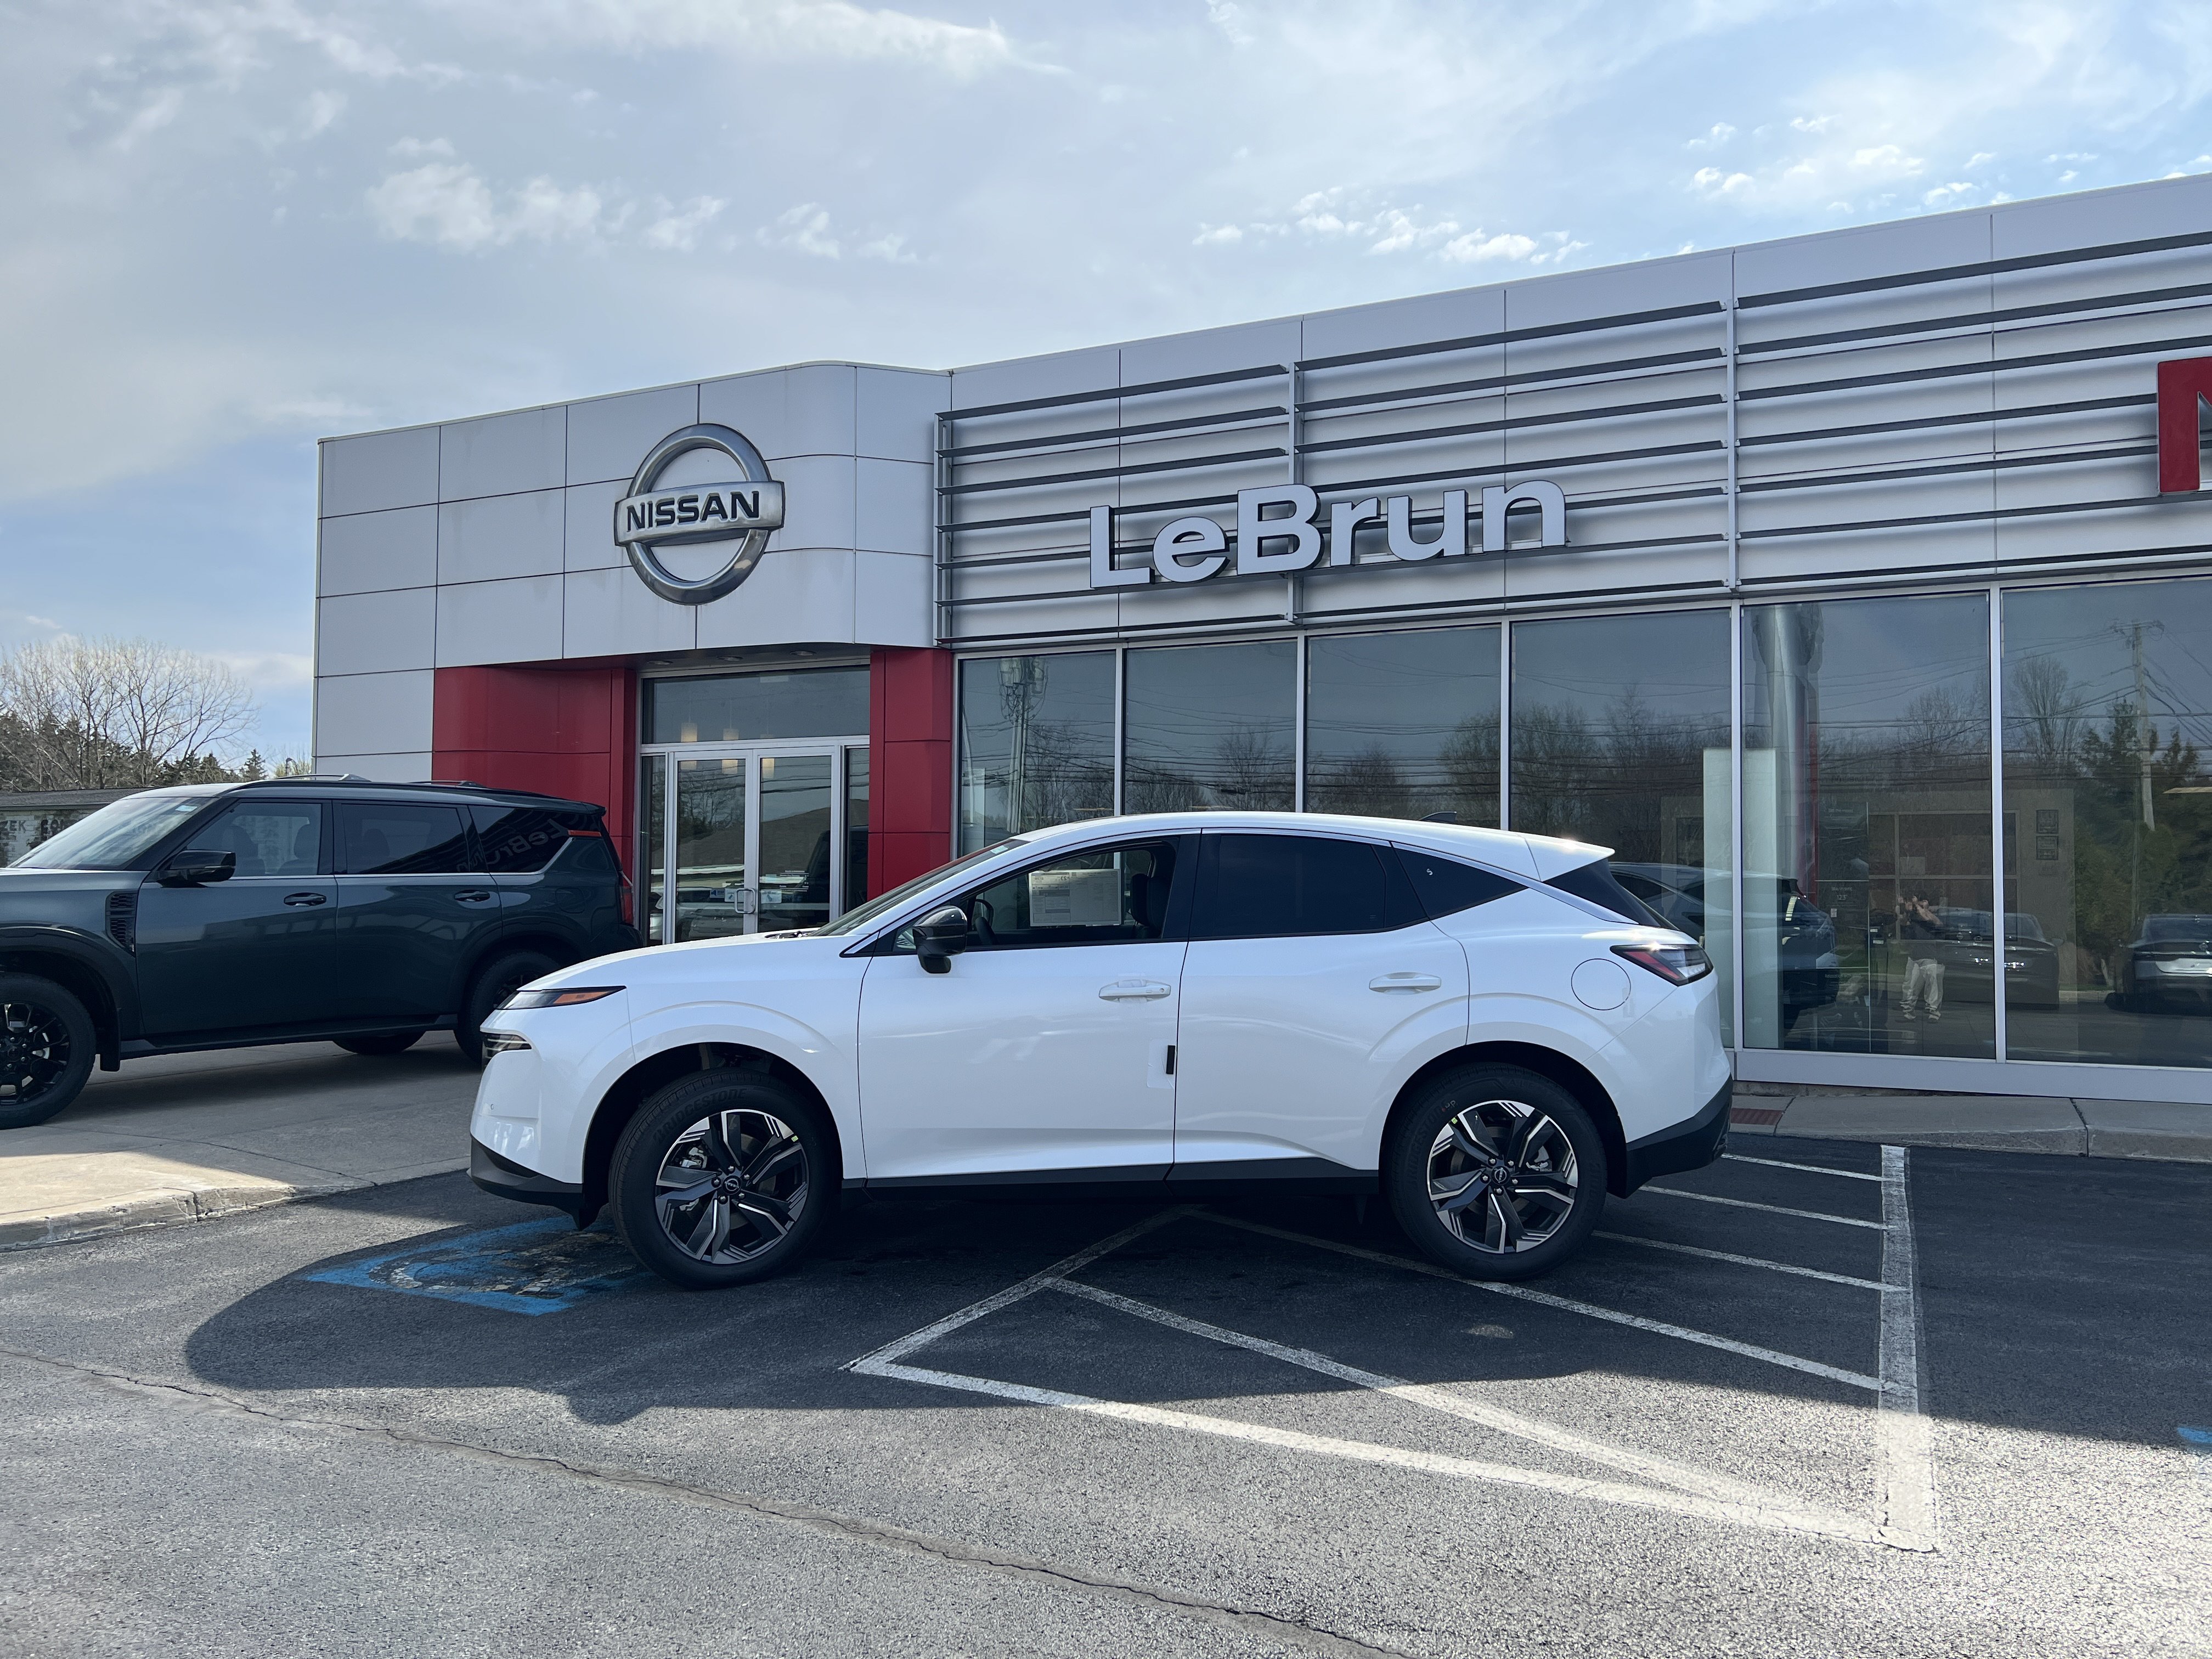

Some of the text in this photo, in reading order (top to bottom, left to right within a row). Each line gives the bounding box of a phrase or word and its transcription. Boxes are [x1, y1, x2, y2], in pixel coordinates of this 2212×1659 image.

[626, 490, 760, 533] NISSAN
[1090, 479, 1570, 589] LeBrun
[652, 1087, 747, 1144] BRIDGESTONE
